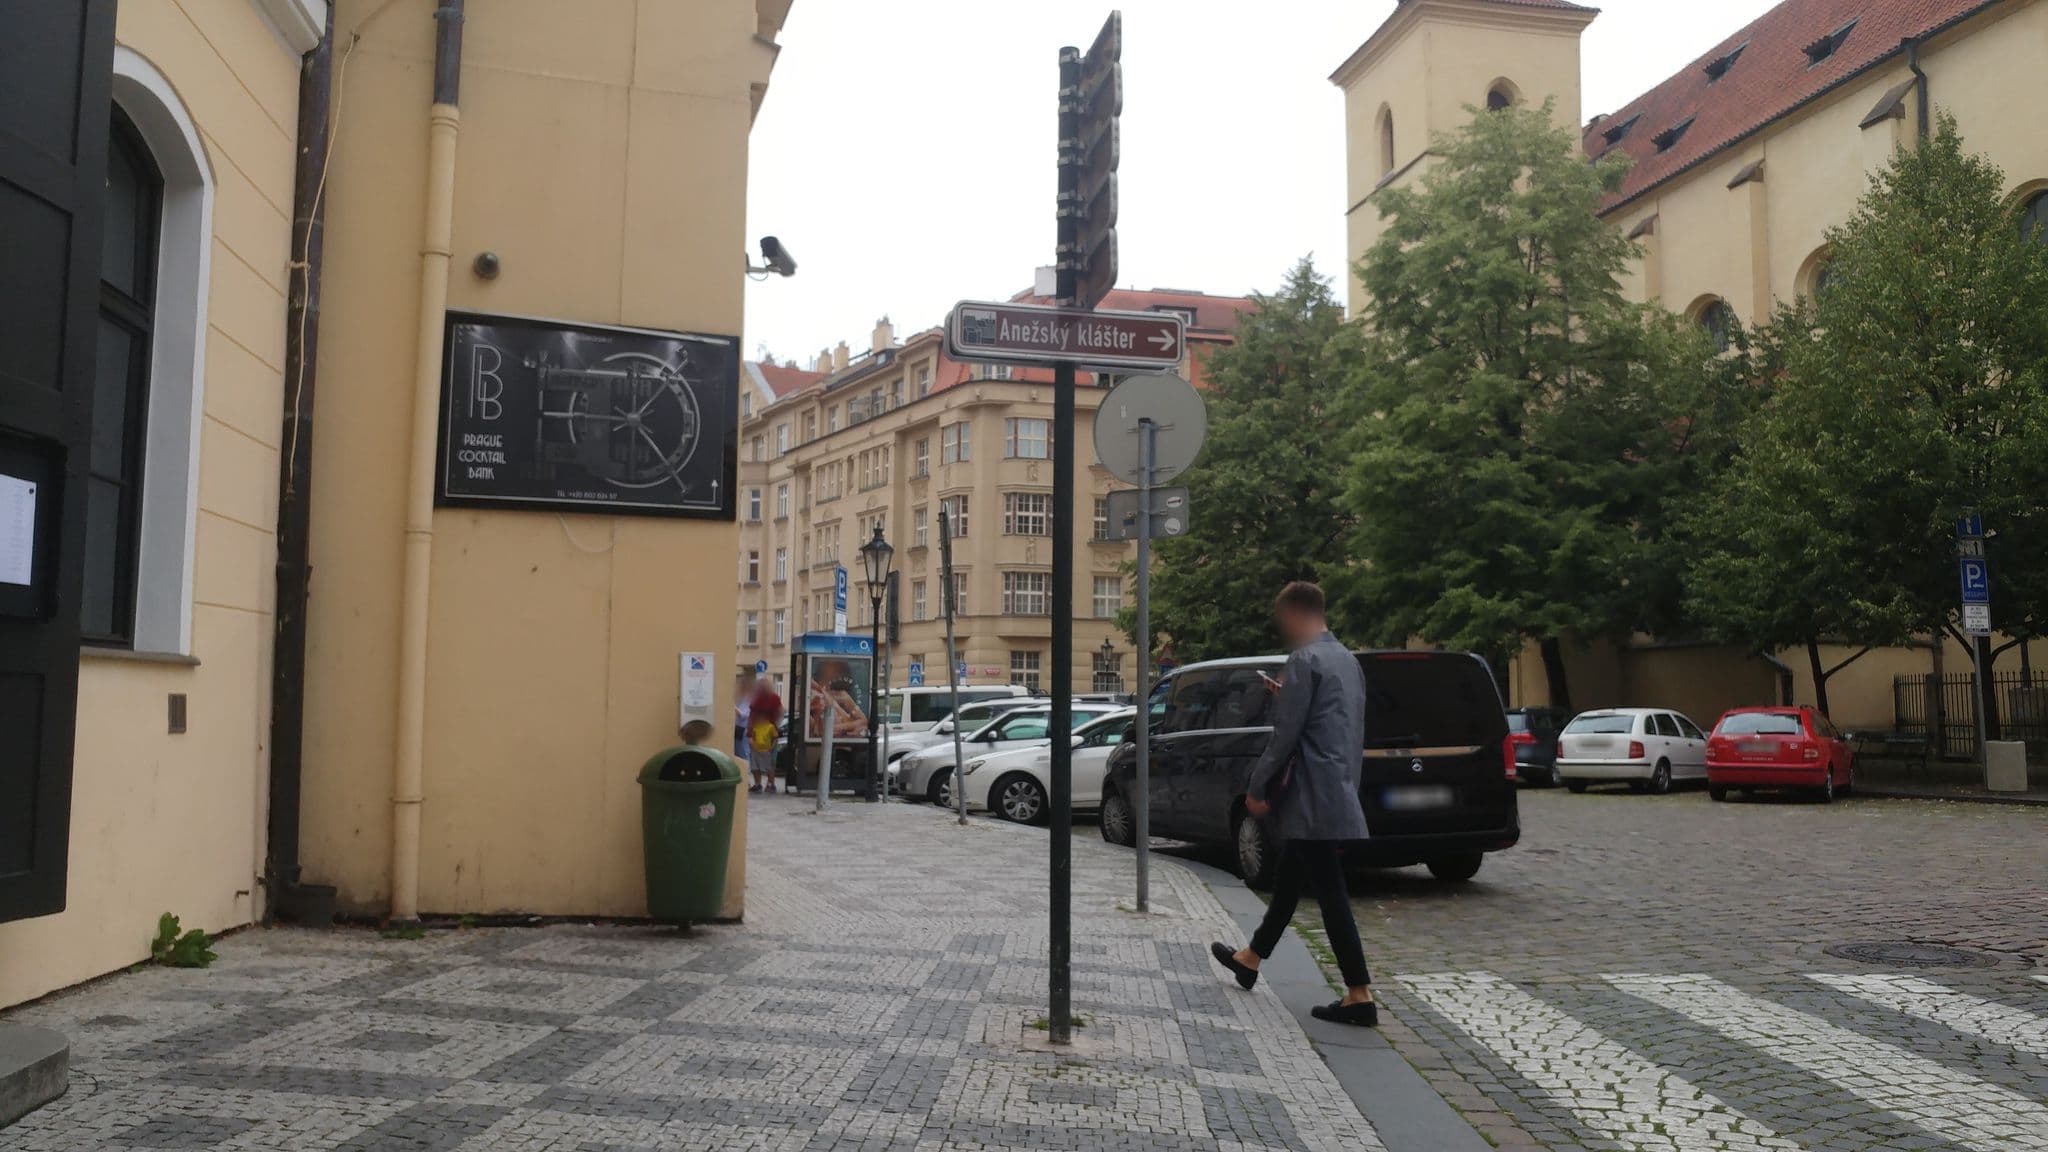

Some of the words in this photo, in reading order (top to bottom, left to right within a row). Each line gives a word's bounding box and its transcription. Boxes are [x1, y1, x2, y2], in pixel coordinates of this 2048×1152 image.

[1000, 317, 1070, 350] Anežský
[1077, 323, 1136, 349] klášter
[464, 433, 503, 448] PRAGUE
[458, 449, 506, 465] COCKTAIL
[468, 466, 495, 480] BANK
[1966, 563, 1981, 589] P
